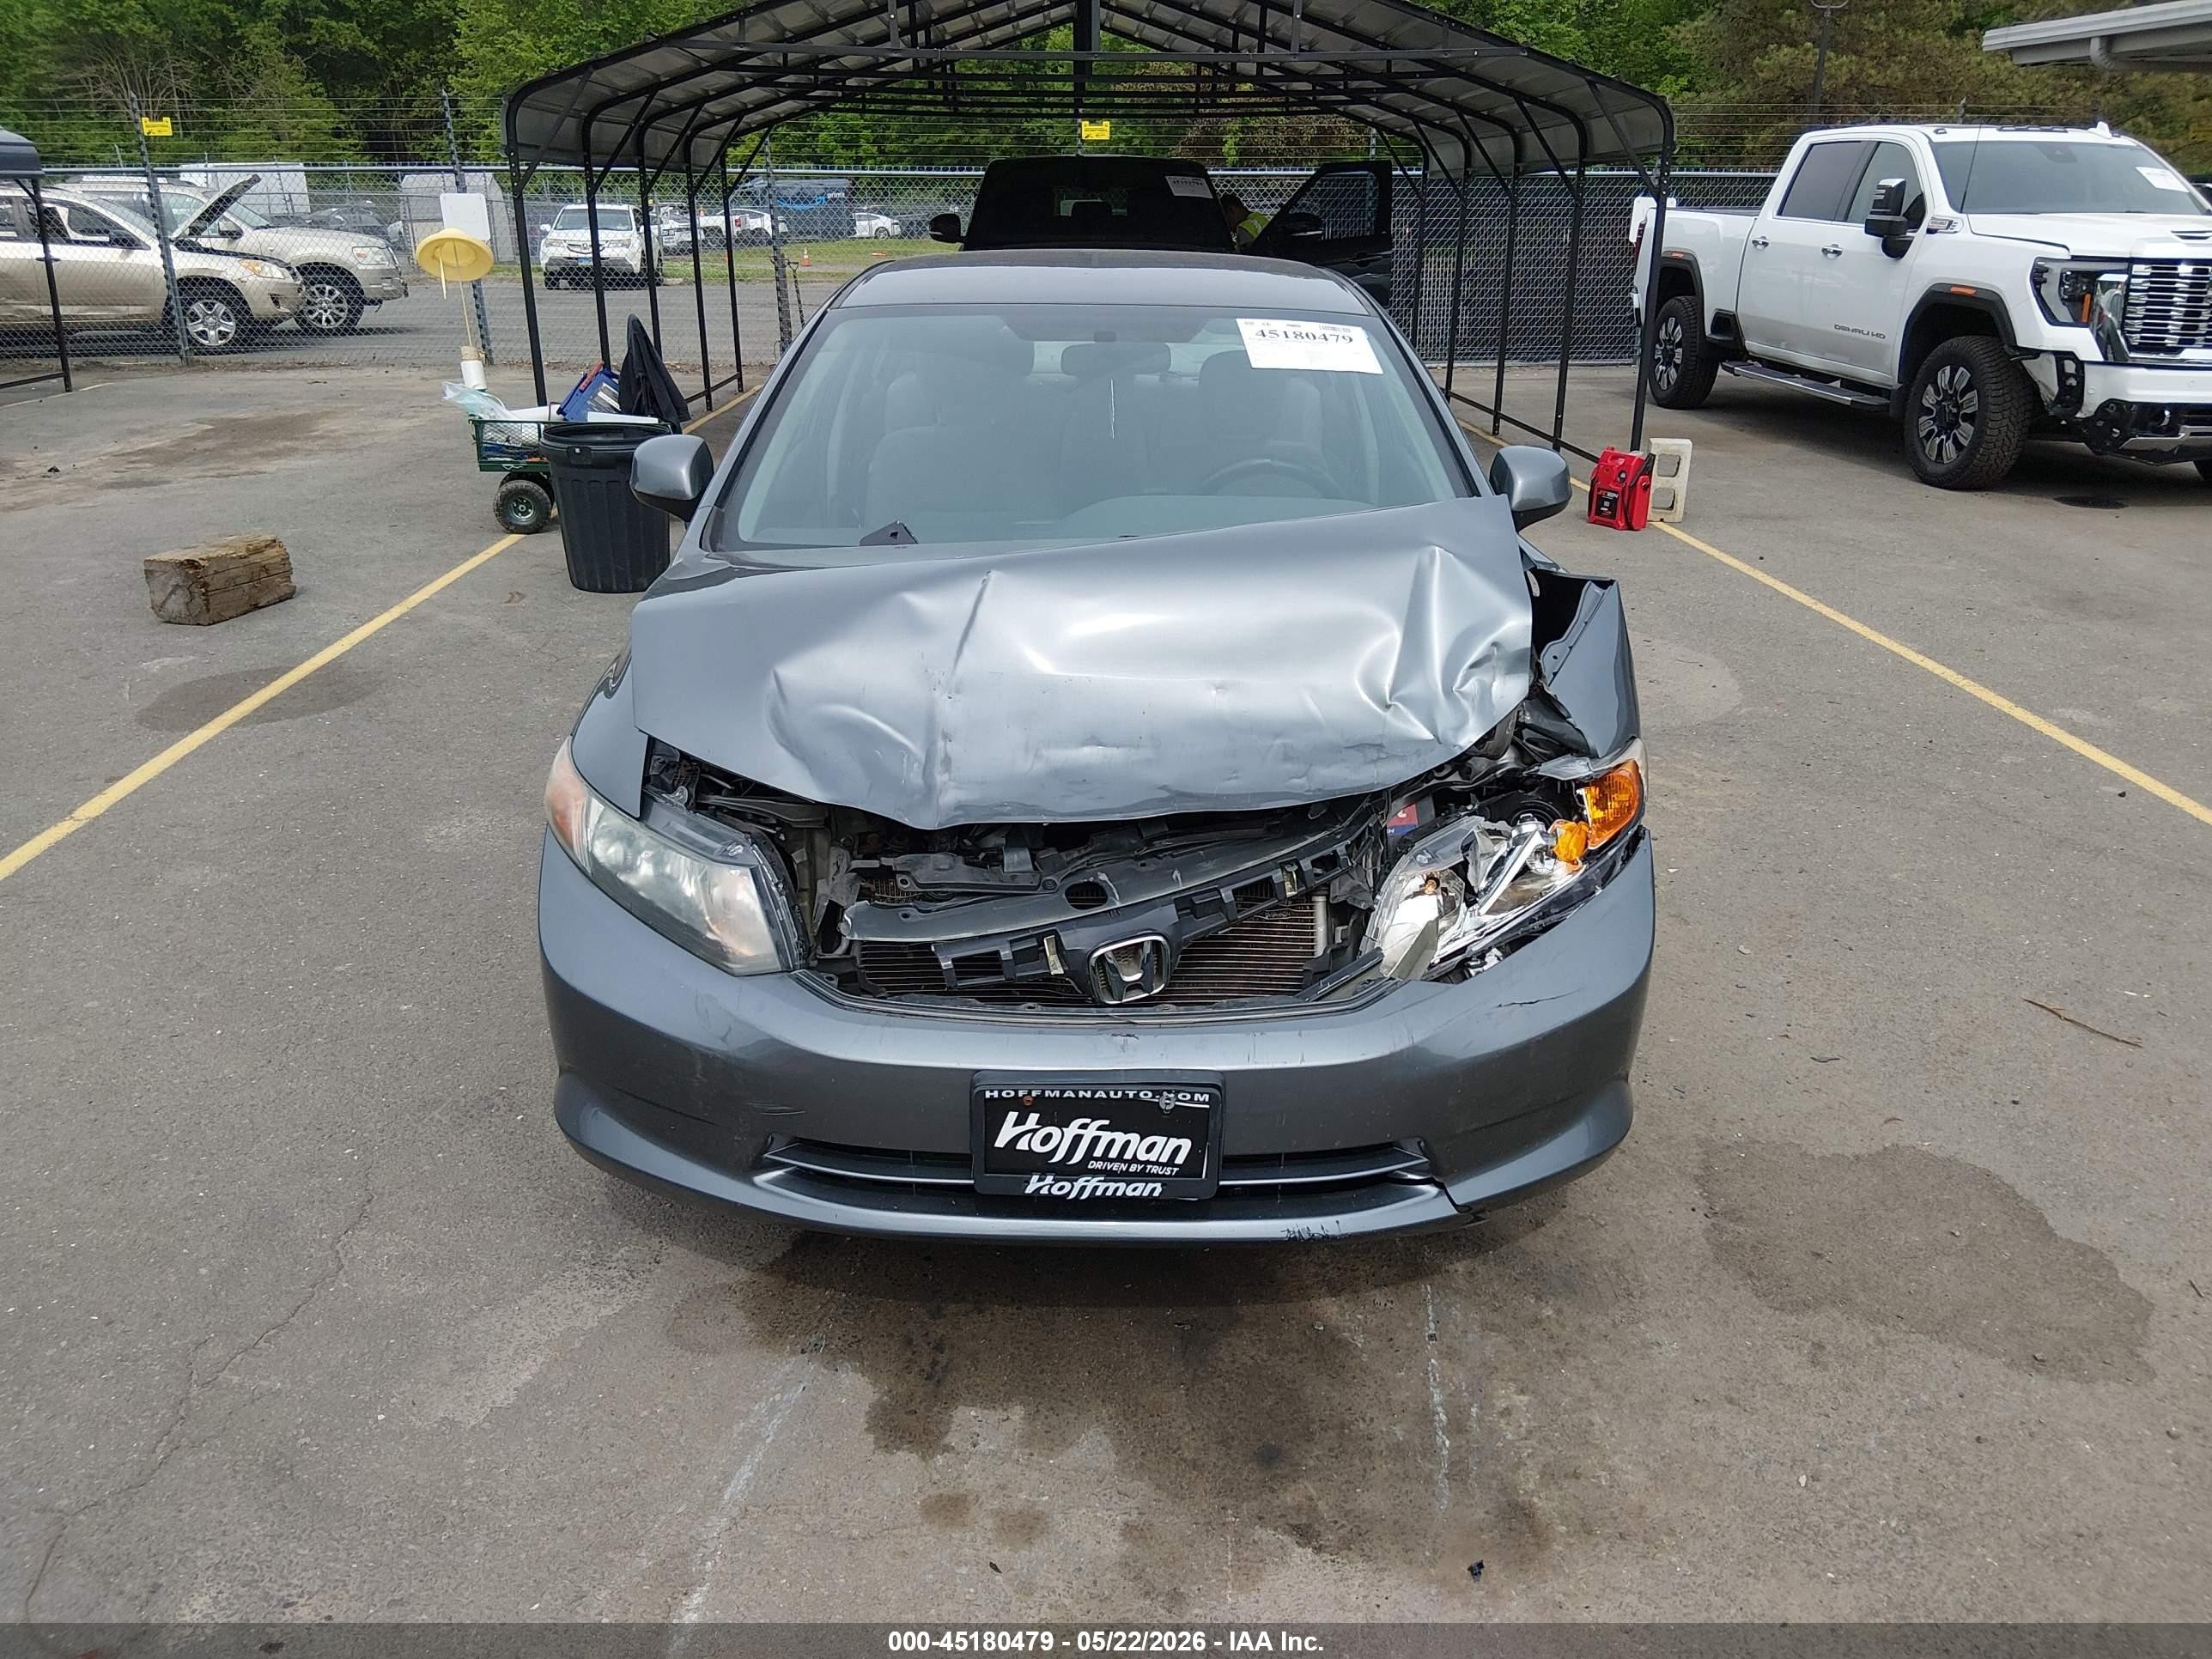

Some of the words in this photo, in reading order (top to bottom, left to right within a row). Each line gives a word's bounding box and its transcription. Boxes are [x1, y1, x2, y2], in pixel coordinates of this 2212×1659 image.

[1255, 329, 1354, 344] 45180479
[994, 1111, 1191, 1164] Hoffman
[1087, 1161, 1127, 1173] DRIVEN
[1128, 1163, 1146, 1174] BY
[1146, 1165, 1179, 1176] TRUST
[1024, 1174, 1164, 1200] Hoffman
